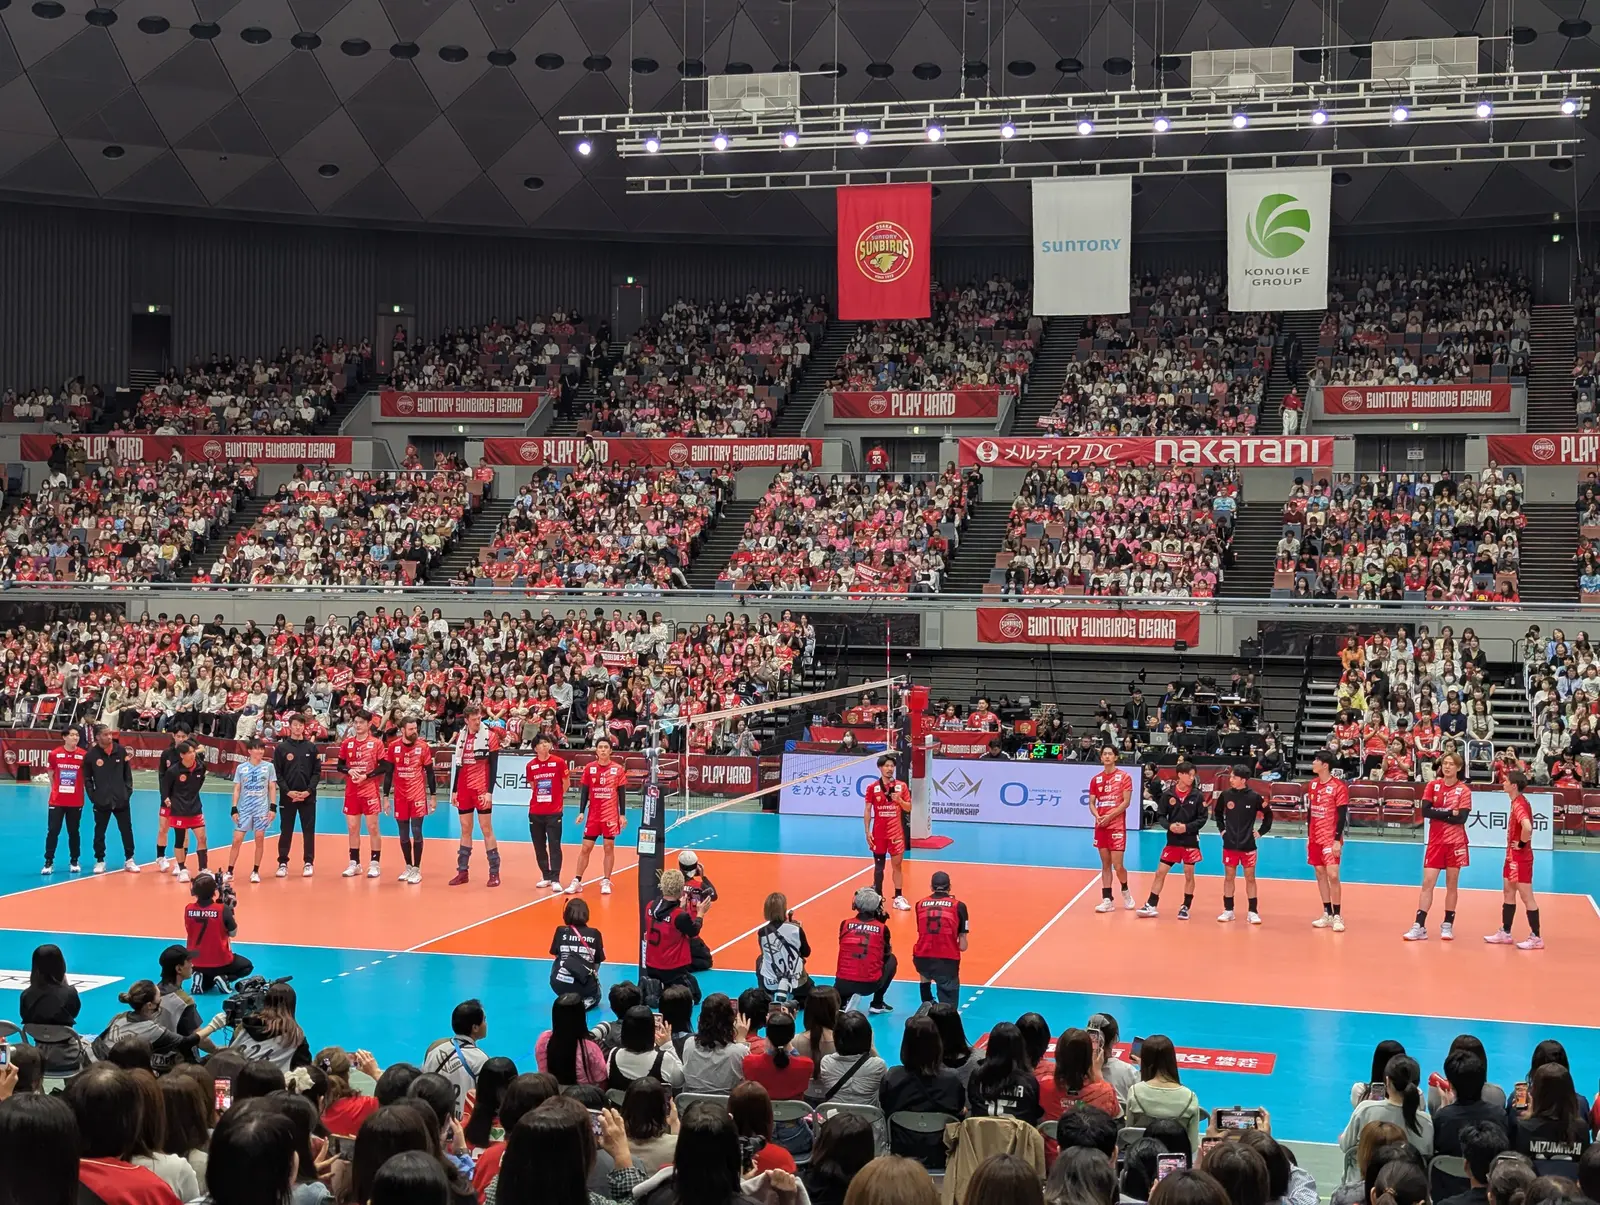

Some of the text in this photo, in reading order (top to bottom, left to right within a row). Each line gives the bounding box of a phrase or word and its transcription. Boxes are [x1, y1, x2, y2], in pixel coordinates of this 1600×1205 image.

[860, 239, 909, 261] SUNBIRDS
[1042, 238, 1121, 253] SUNTORY
[1245, 267, 1310, 276] KONOIKE
[1252, 278, 1302, 286] GROUP
[417, 397, 454, 413] SUNTORY
[455, 397, 495, 413] SUNBIRDS
[496, 397, 523, 413] OSAKA
[891, 393, 956, 416] PLAY HARD
[1366, 390, 1492, 409] SUNTORY SUNBIRDS OSAKA
[225, 441, 263, 458] SUNTORY
[265, 442, 306, 459] SUNBIRDS
[307, 442, 336, 459] OSAKA
[543, 440, 574, 464] PLAY
[691, 444, 730, 461] SUNTORY
[732, 444, 775, 461] SUNBIRDS
[776, 444, 806, 461] OSAKA
[1560, 435, 1599, 463] PLAY
[872, 455, 882, 465] 33
[1027, 616, 1176, 639] SUNTORY SUNBIRDS OSAKA
[702, 765, 752, 785] PLAY HARD
[791, 785, 851, 797] をかなえる
[931, 806, 980, 816] CHAMPIONSHIP
[1468, 810, 1550, 832] 大同命
[201, 910, 217, 918] PRESS
[195, 918, 208, 945] 7
[863, 924, 880, 933] PRESS
[852, 932, 870, 959] 3
